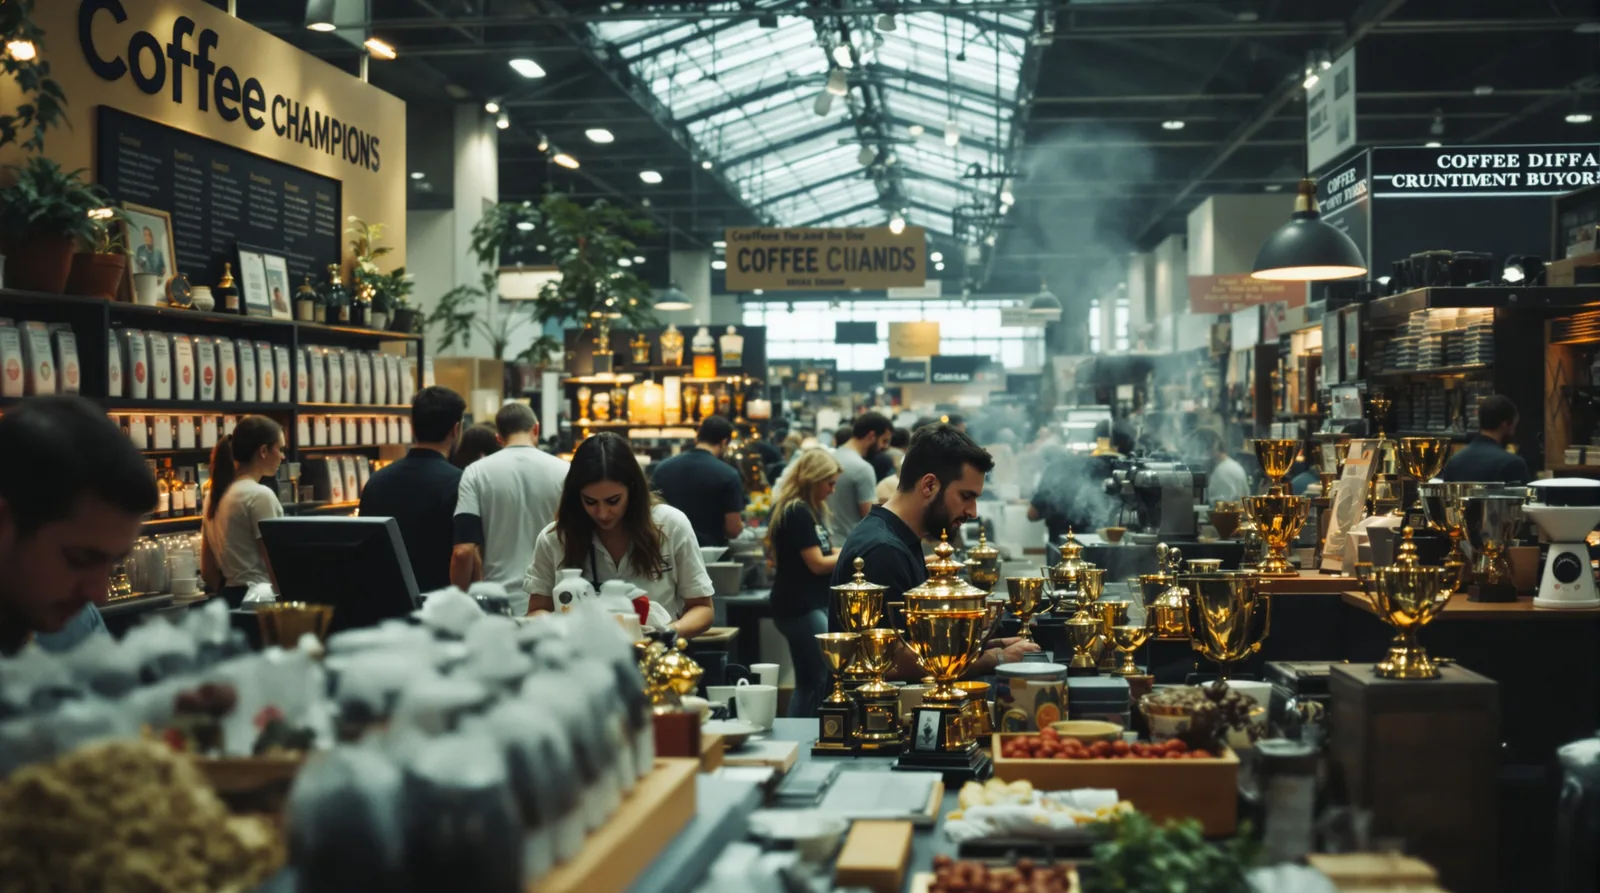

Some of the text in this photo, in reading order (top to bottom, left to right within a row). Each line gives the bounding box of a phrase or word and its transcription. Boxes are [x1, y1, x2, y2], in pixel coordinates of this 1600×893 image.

[78, 0, 266, 131] Coffee
[271, 94, 380, 173] CHAMPIONS
[1437, 152, 1599, 169] COFFEE DIFFA
[1391, 172, 1520, 188] CRUNTIMENT
[737, 246, 819, 273] COFFEE
